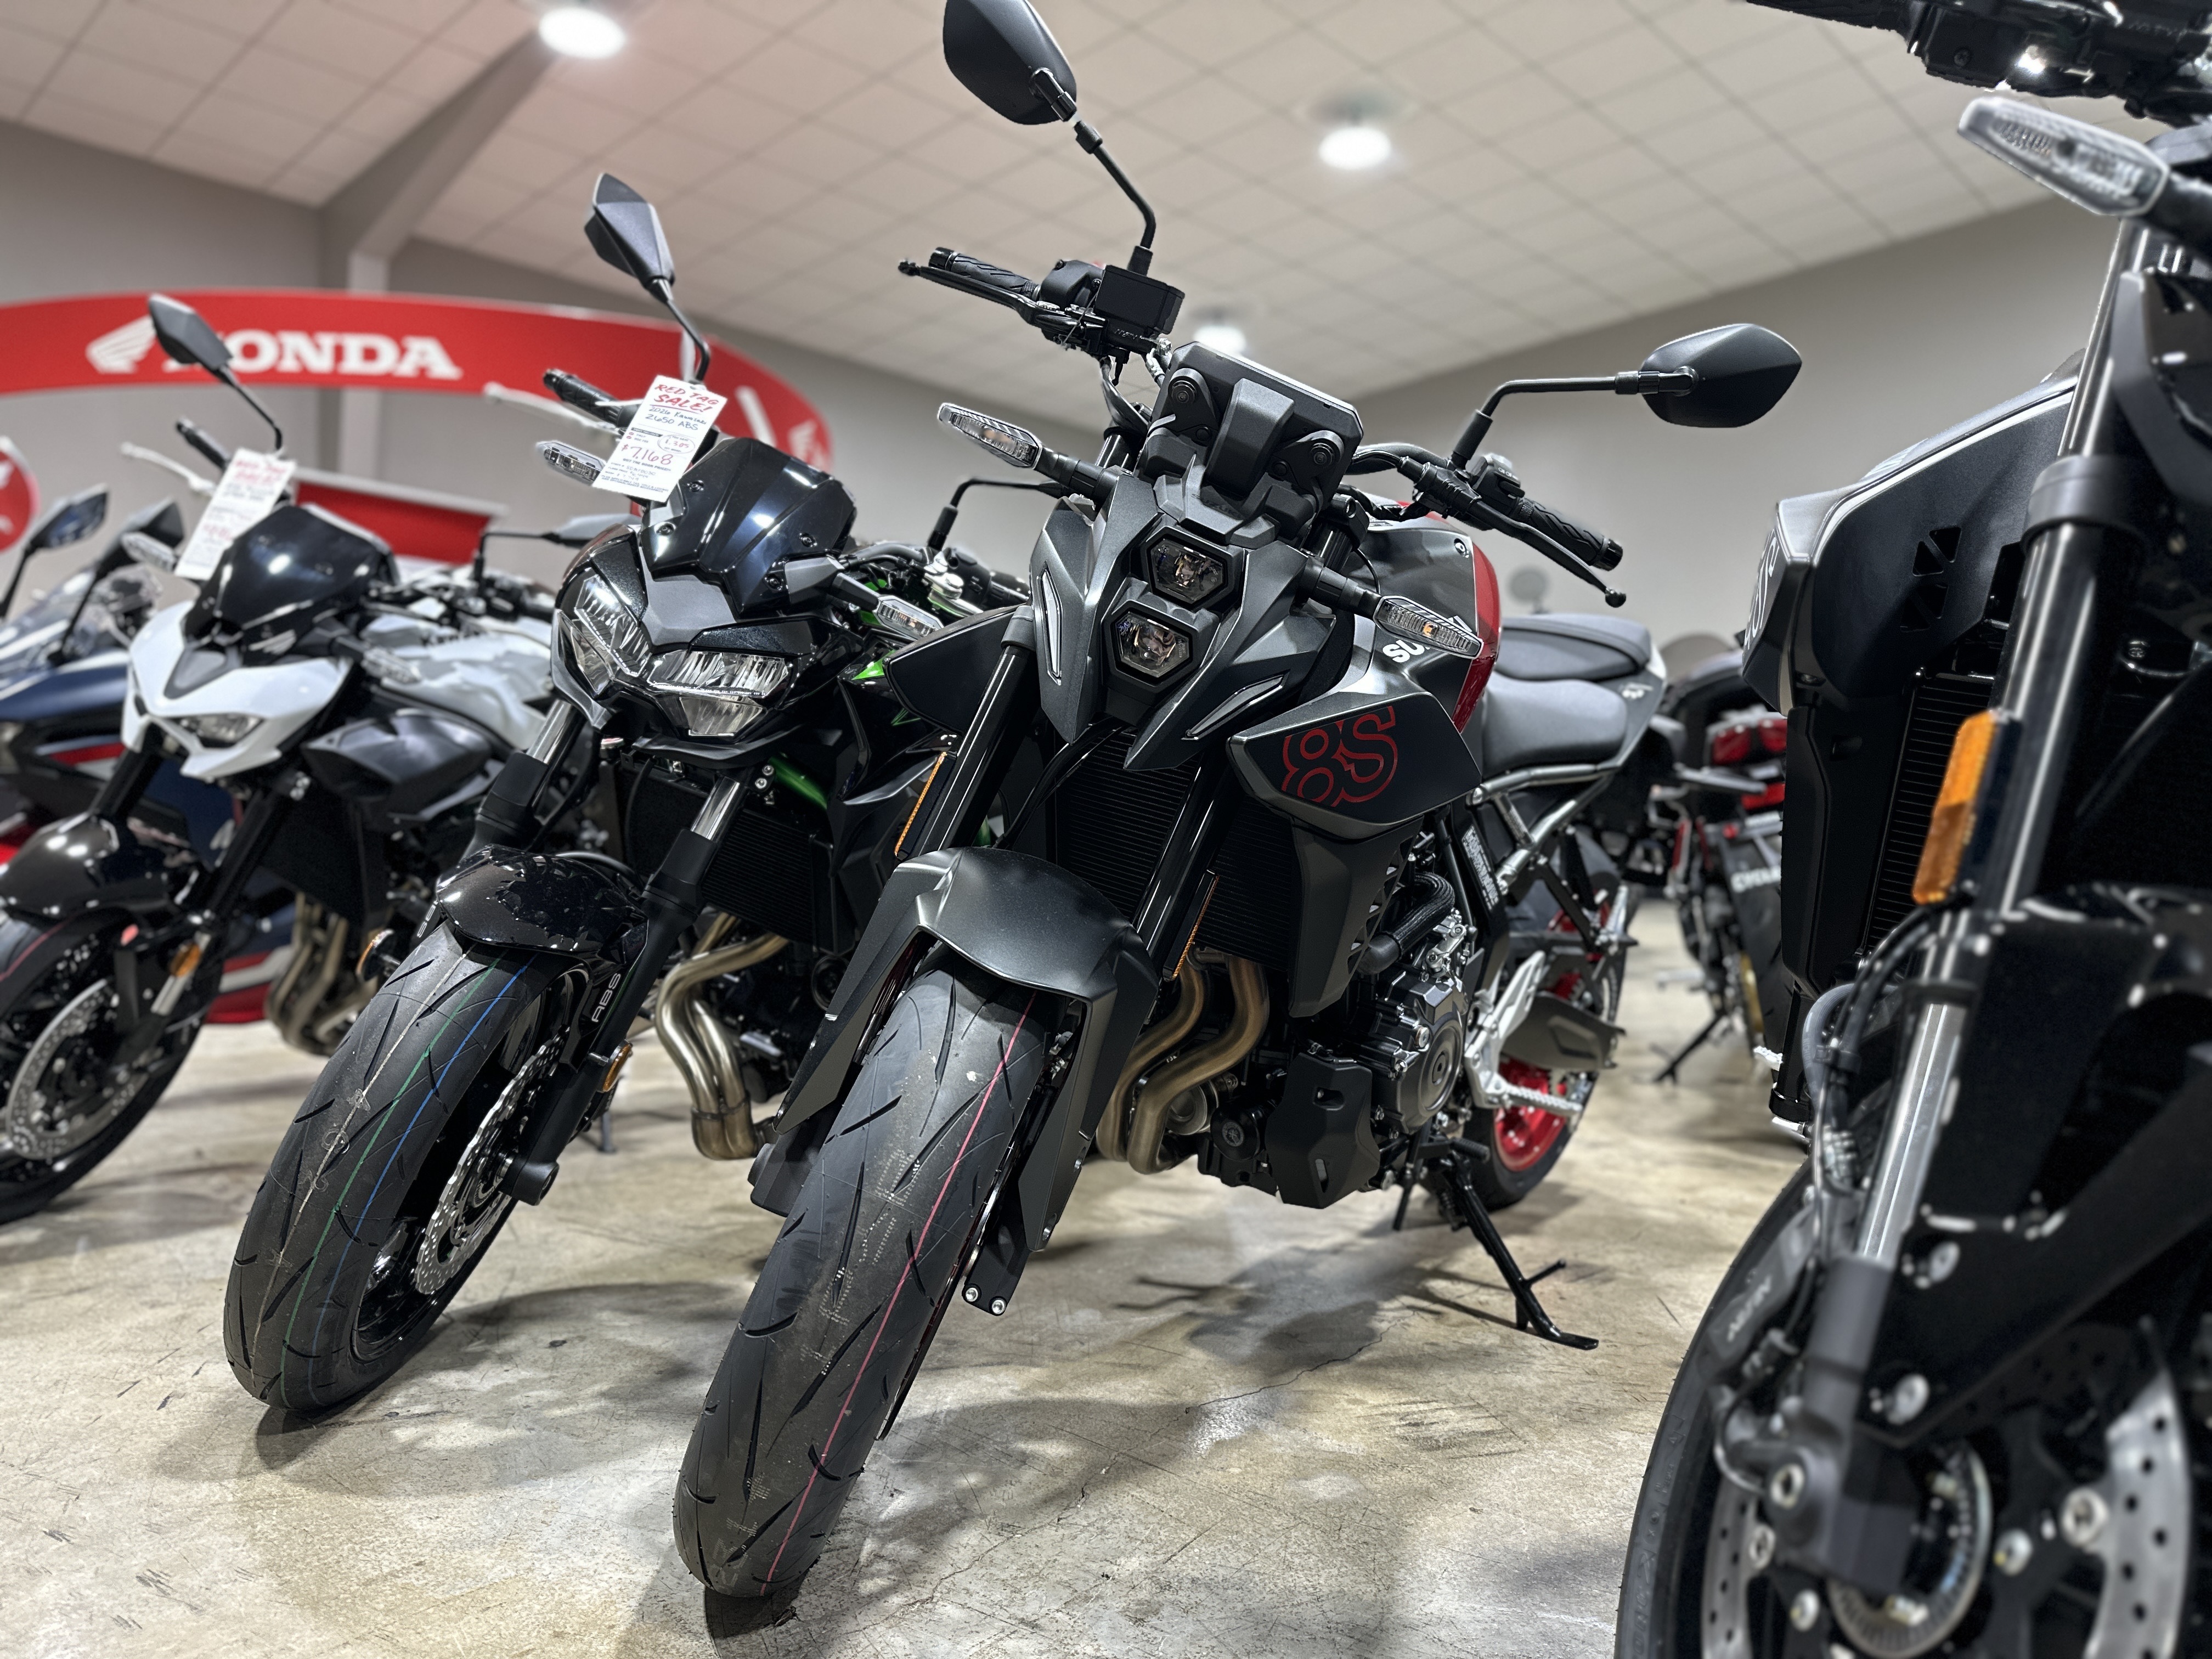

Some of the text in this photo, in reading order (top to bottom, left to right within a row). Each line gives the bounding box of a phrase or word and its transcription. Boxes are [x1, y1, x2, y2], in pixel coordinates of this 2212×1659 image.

[163, 329, 462, 380] ONDA
[654, 385, 719, 404] RED TAG
[654, 394, 713, 412] SALE!
[645, 414, 698, 430] Z650 ABS
[1281, 706, 1398, 808] 8S
[591, 973, 621, 1022] ABS
